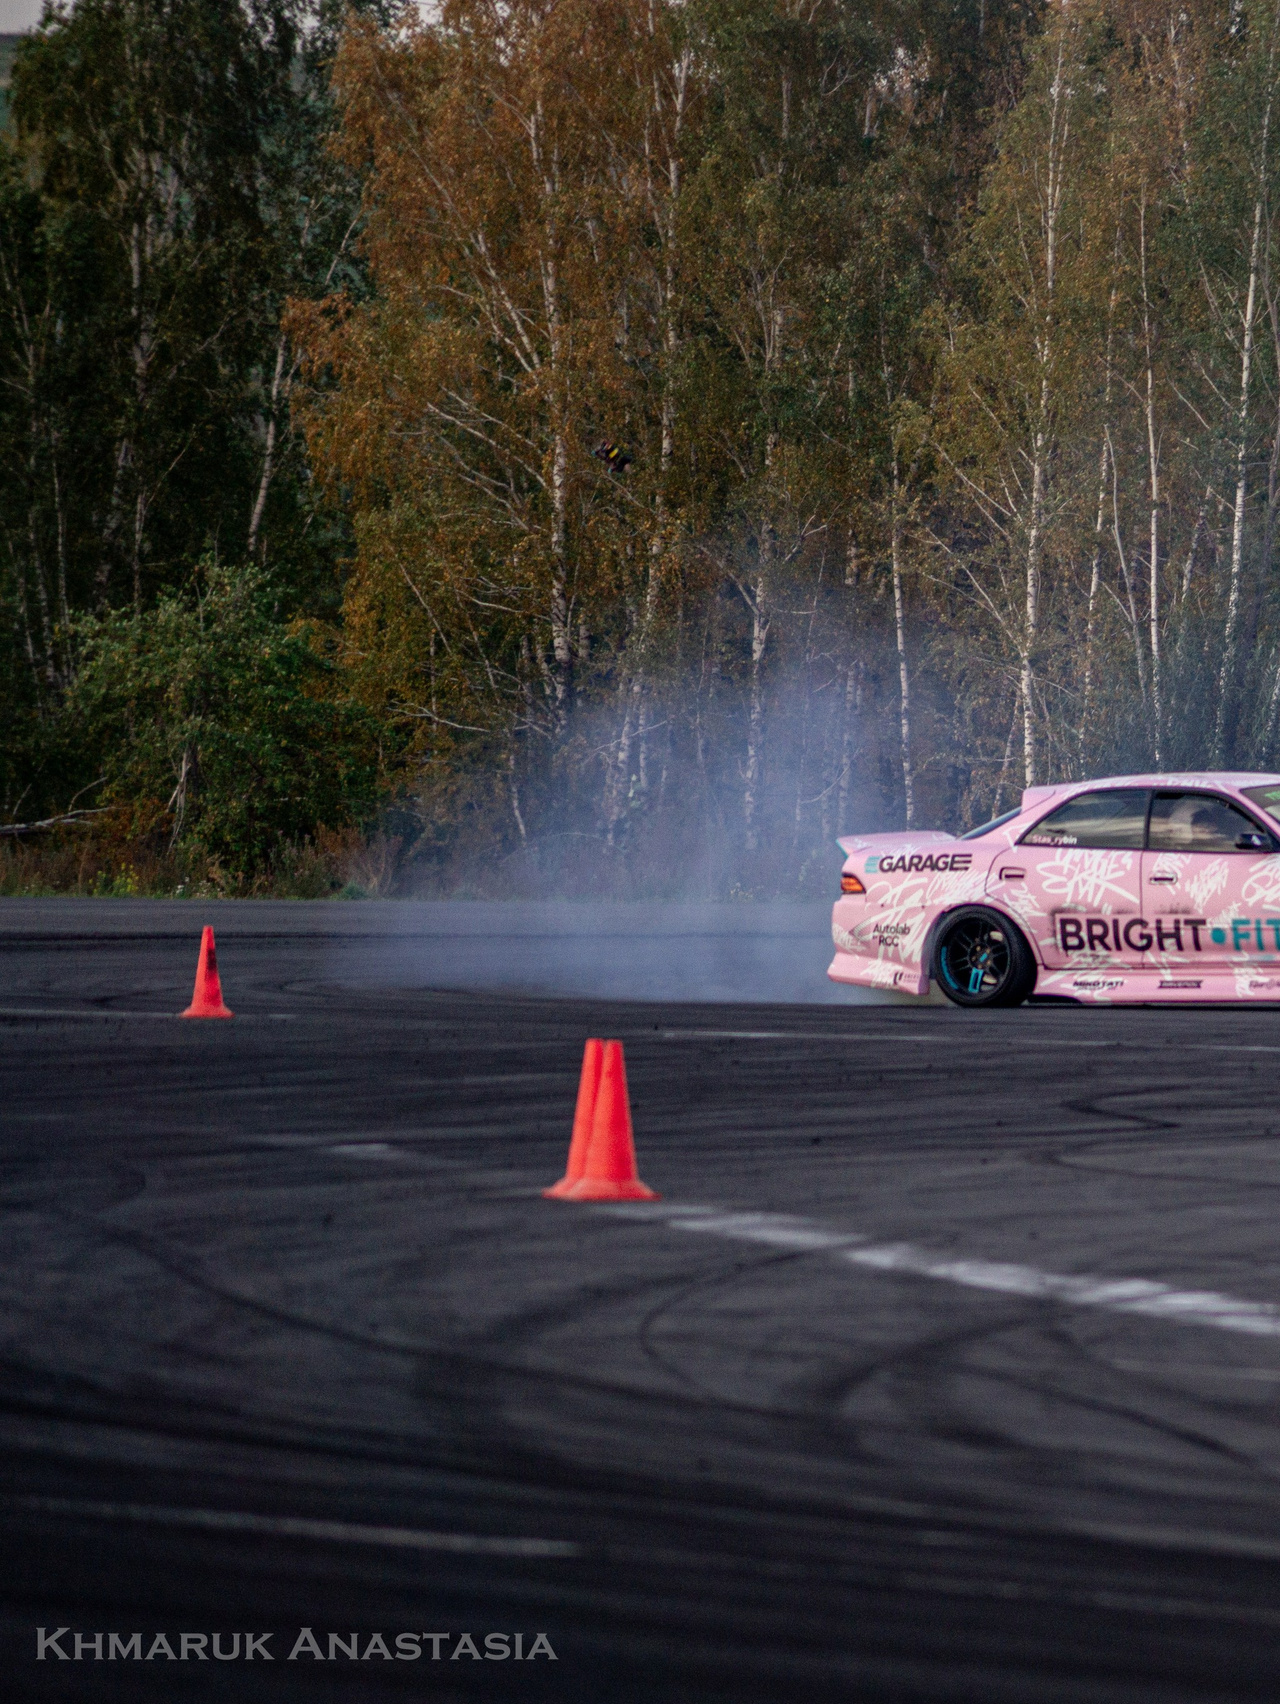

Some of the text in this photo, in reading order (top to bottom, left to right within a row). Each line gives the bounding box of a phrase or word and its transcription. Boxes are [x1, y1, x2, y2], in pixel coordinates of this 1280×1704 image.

[879, 853, 973, 873] GARAGE
[873, 923, 911, 936] Autolab
[1059, 918, 1207, 952] BRIGHT
[879, 935, 899, 947] RCC
